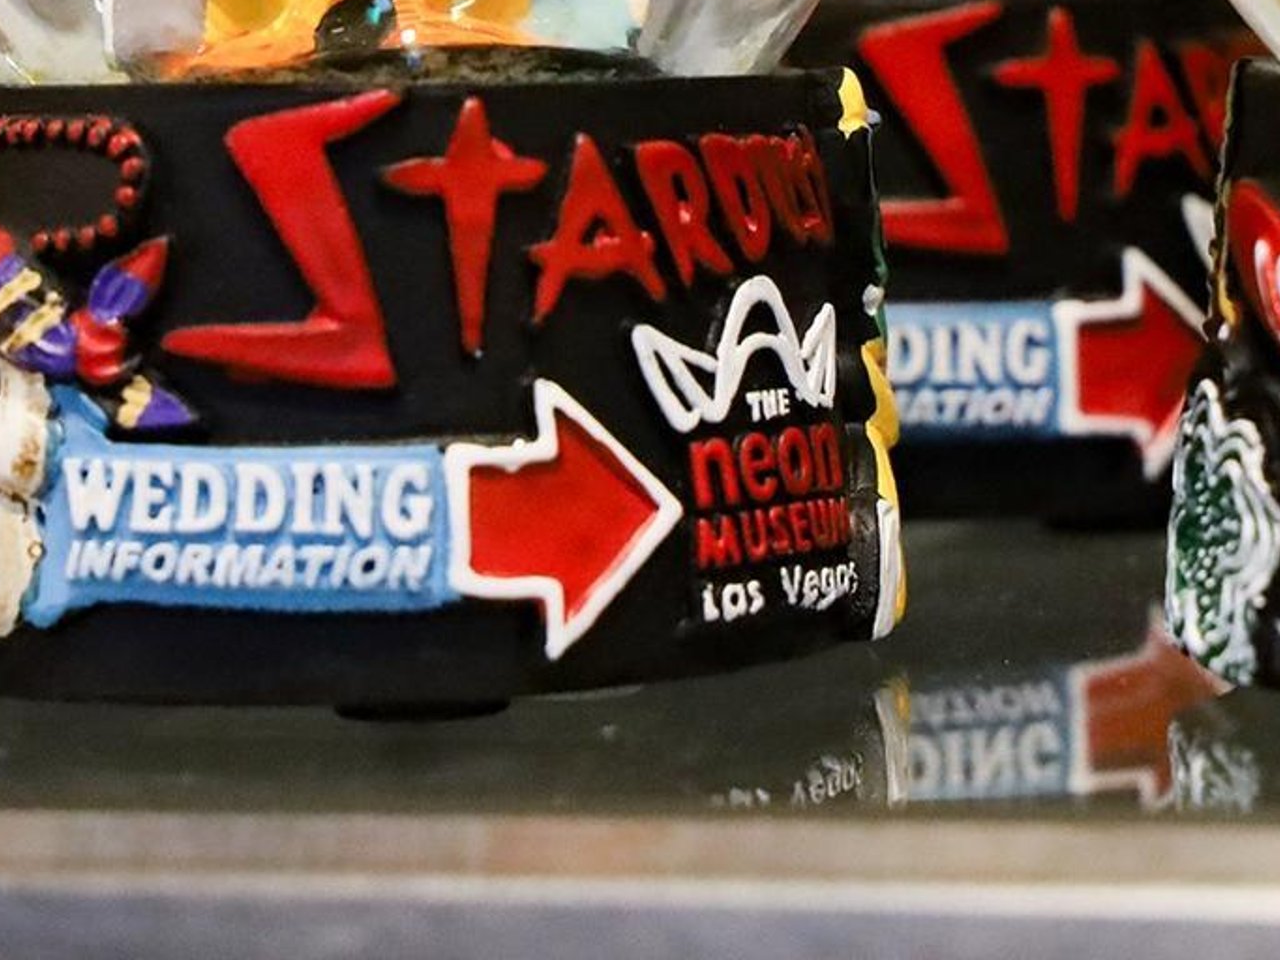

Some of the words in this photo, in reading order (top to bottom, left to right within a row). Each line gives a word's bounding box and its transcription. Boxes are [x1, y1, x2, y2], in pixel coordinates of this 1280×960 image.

[886, 318, 1052, 386] DING
[745, 387, 791, 423] THE
[897, 387, 1054, 428] ATION
[62, 456, 434, 540] WEDDING
[689, 420, 844, 509] neon
[64, 540, 433, 592] INFORMATION
[696, 496, 851, 571] MUSEUM
